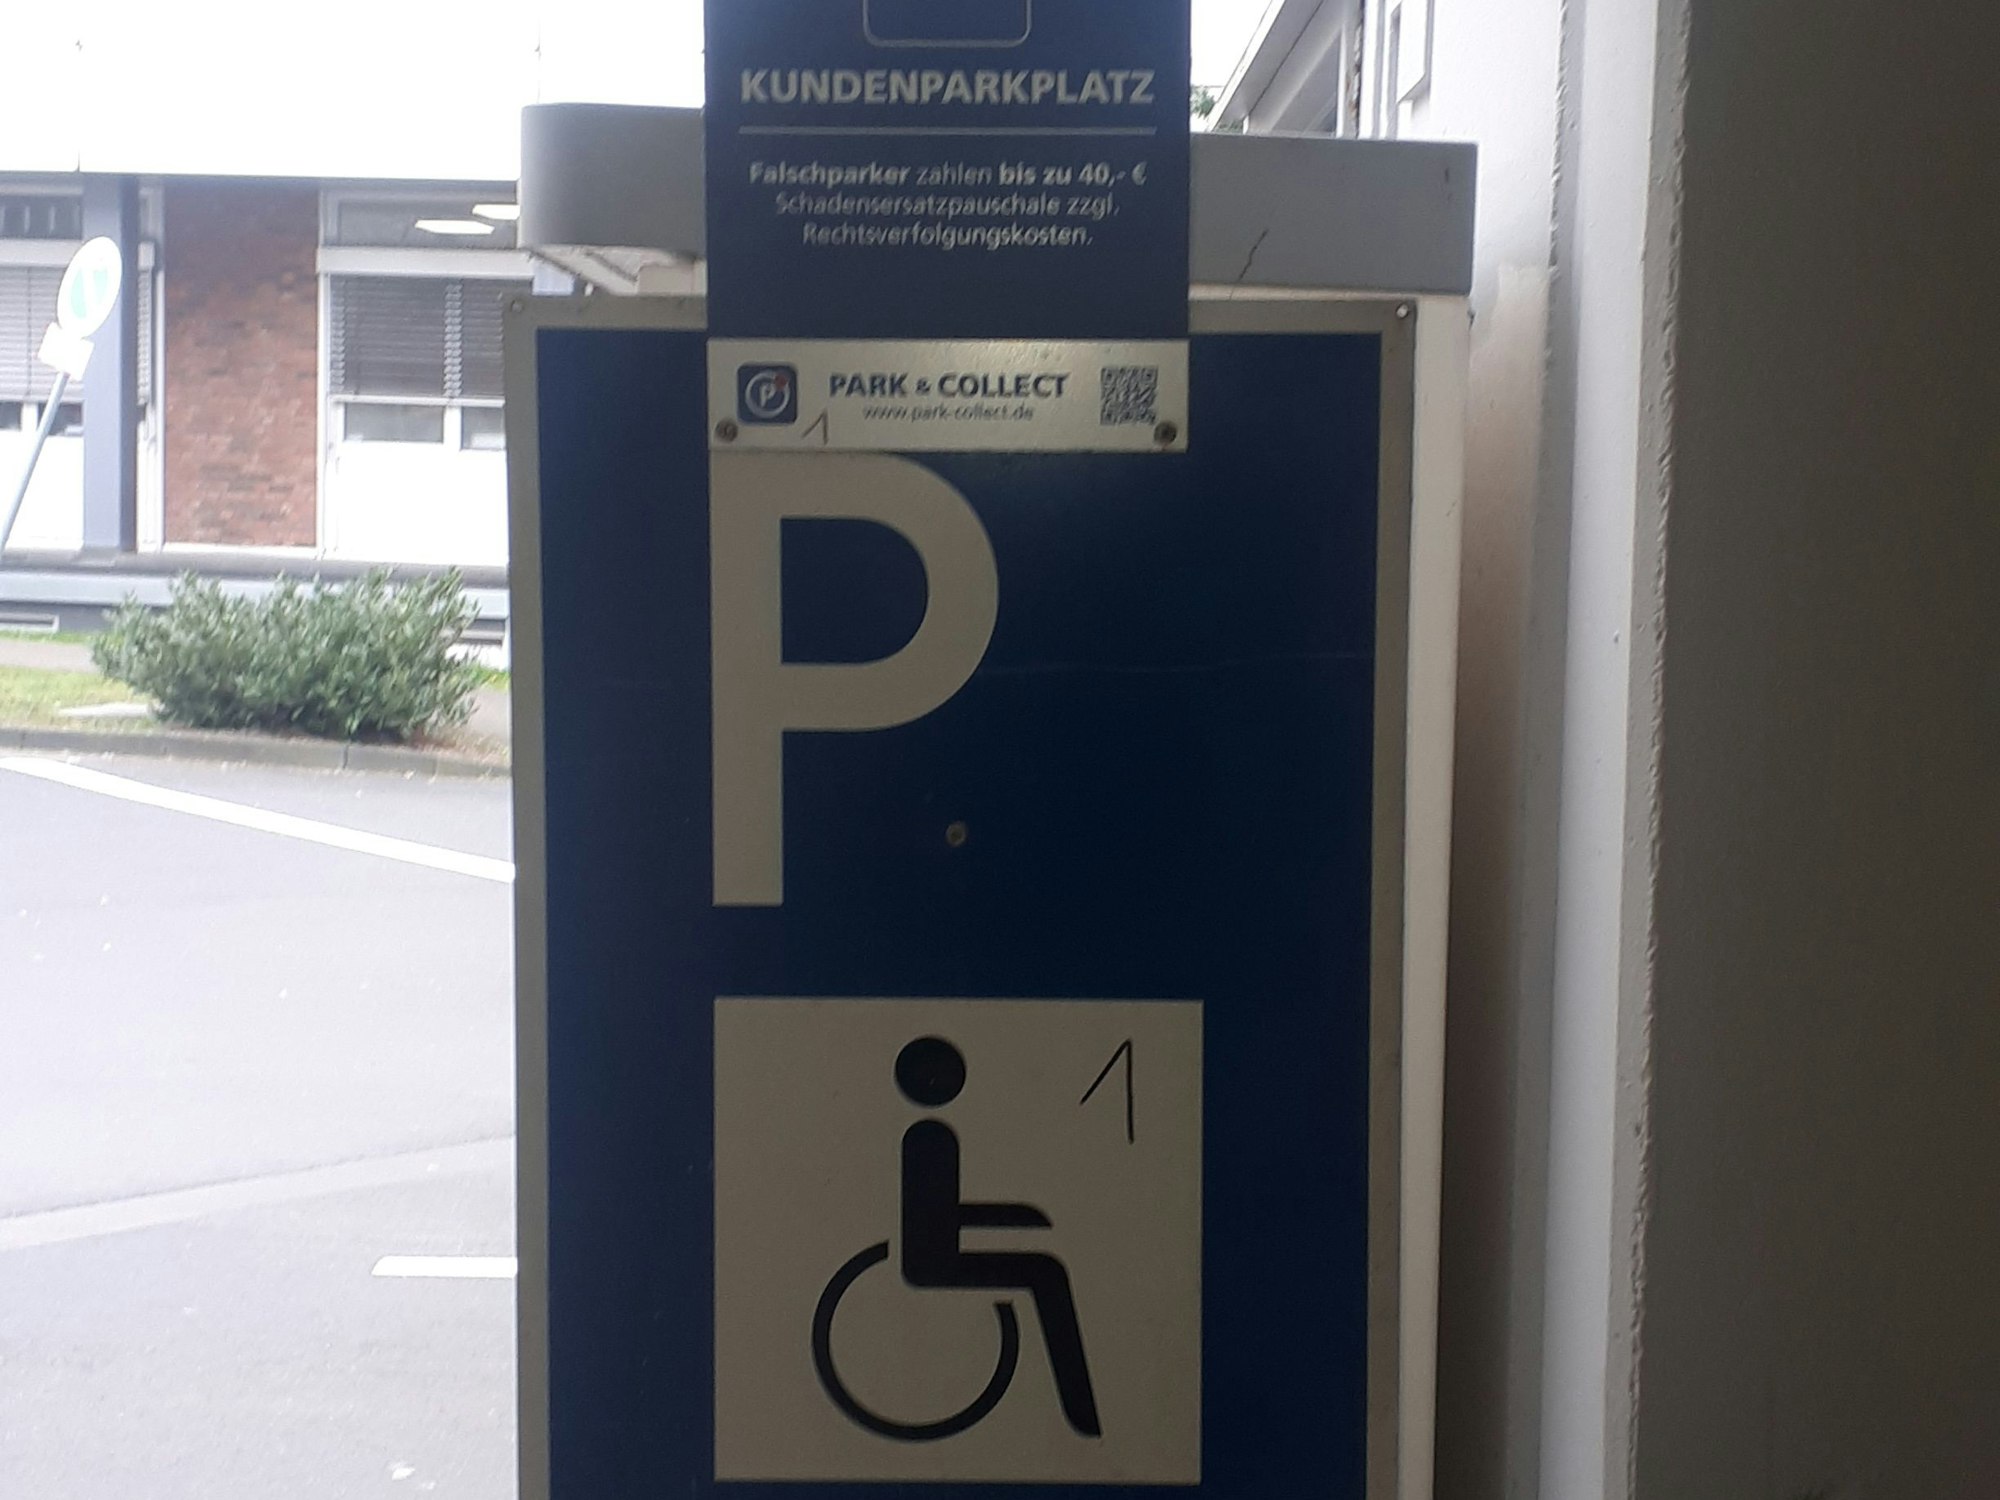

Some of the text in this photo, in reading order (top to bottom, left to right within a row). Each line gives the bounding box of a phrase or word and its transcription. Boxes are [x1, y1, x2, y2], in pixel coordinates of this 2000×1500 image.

[740, 68, 1156, 105] KUNDENPARKPLATZ
[749, 161, 911, 189] Falschparker
[915, 161, 992, 185] zahlen
[999, 161, 1037, 186] bis
[1041, 165, 1073, 186] zu
[1131, 162, 1148, 186] €
[775, 190, 1120, 221] Schadensersatzpauschale zzgl.
[802, 220, 1093, 250] Rechtsverfolgungskosten.
[828, 372, 1070, 398] PARK & COLLECT
[802, 408, 829, 446] 1
[863, 402, 1034, 421] www.park-collect.de
[709, 453, 999, 907] P
[1080, 1038, 1134, 1145] 1
